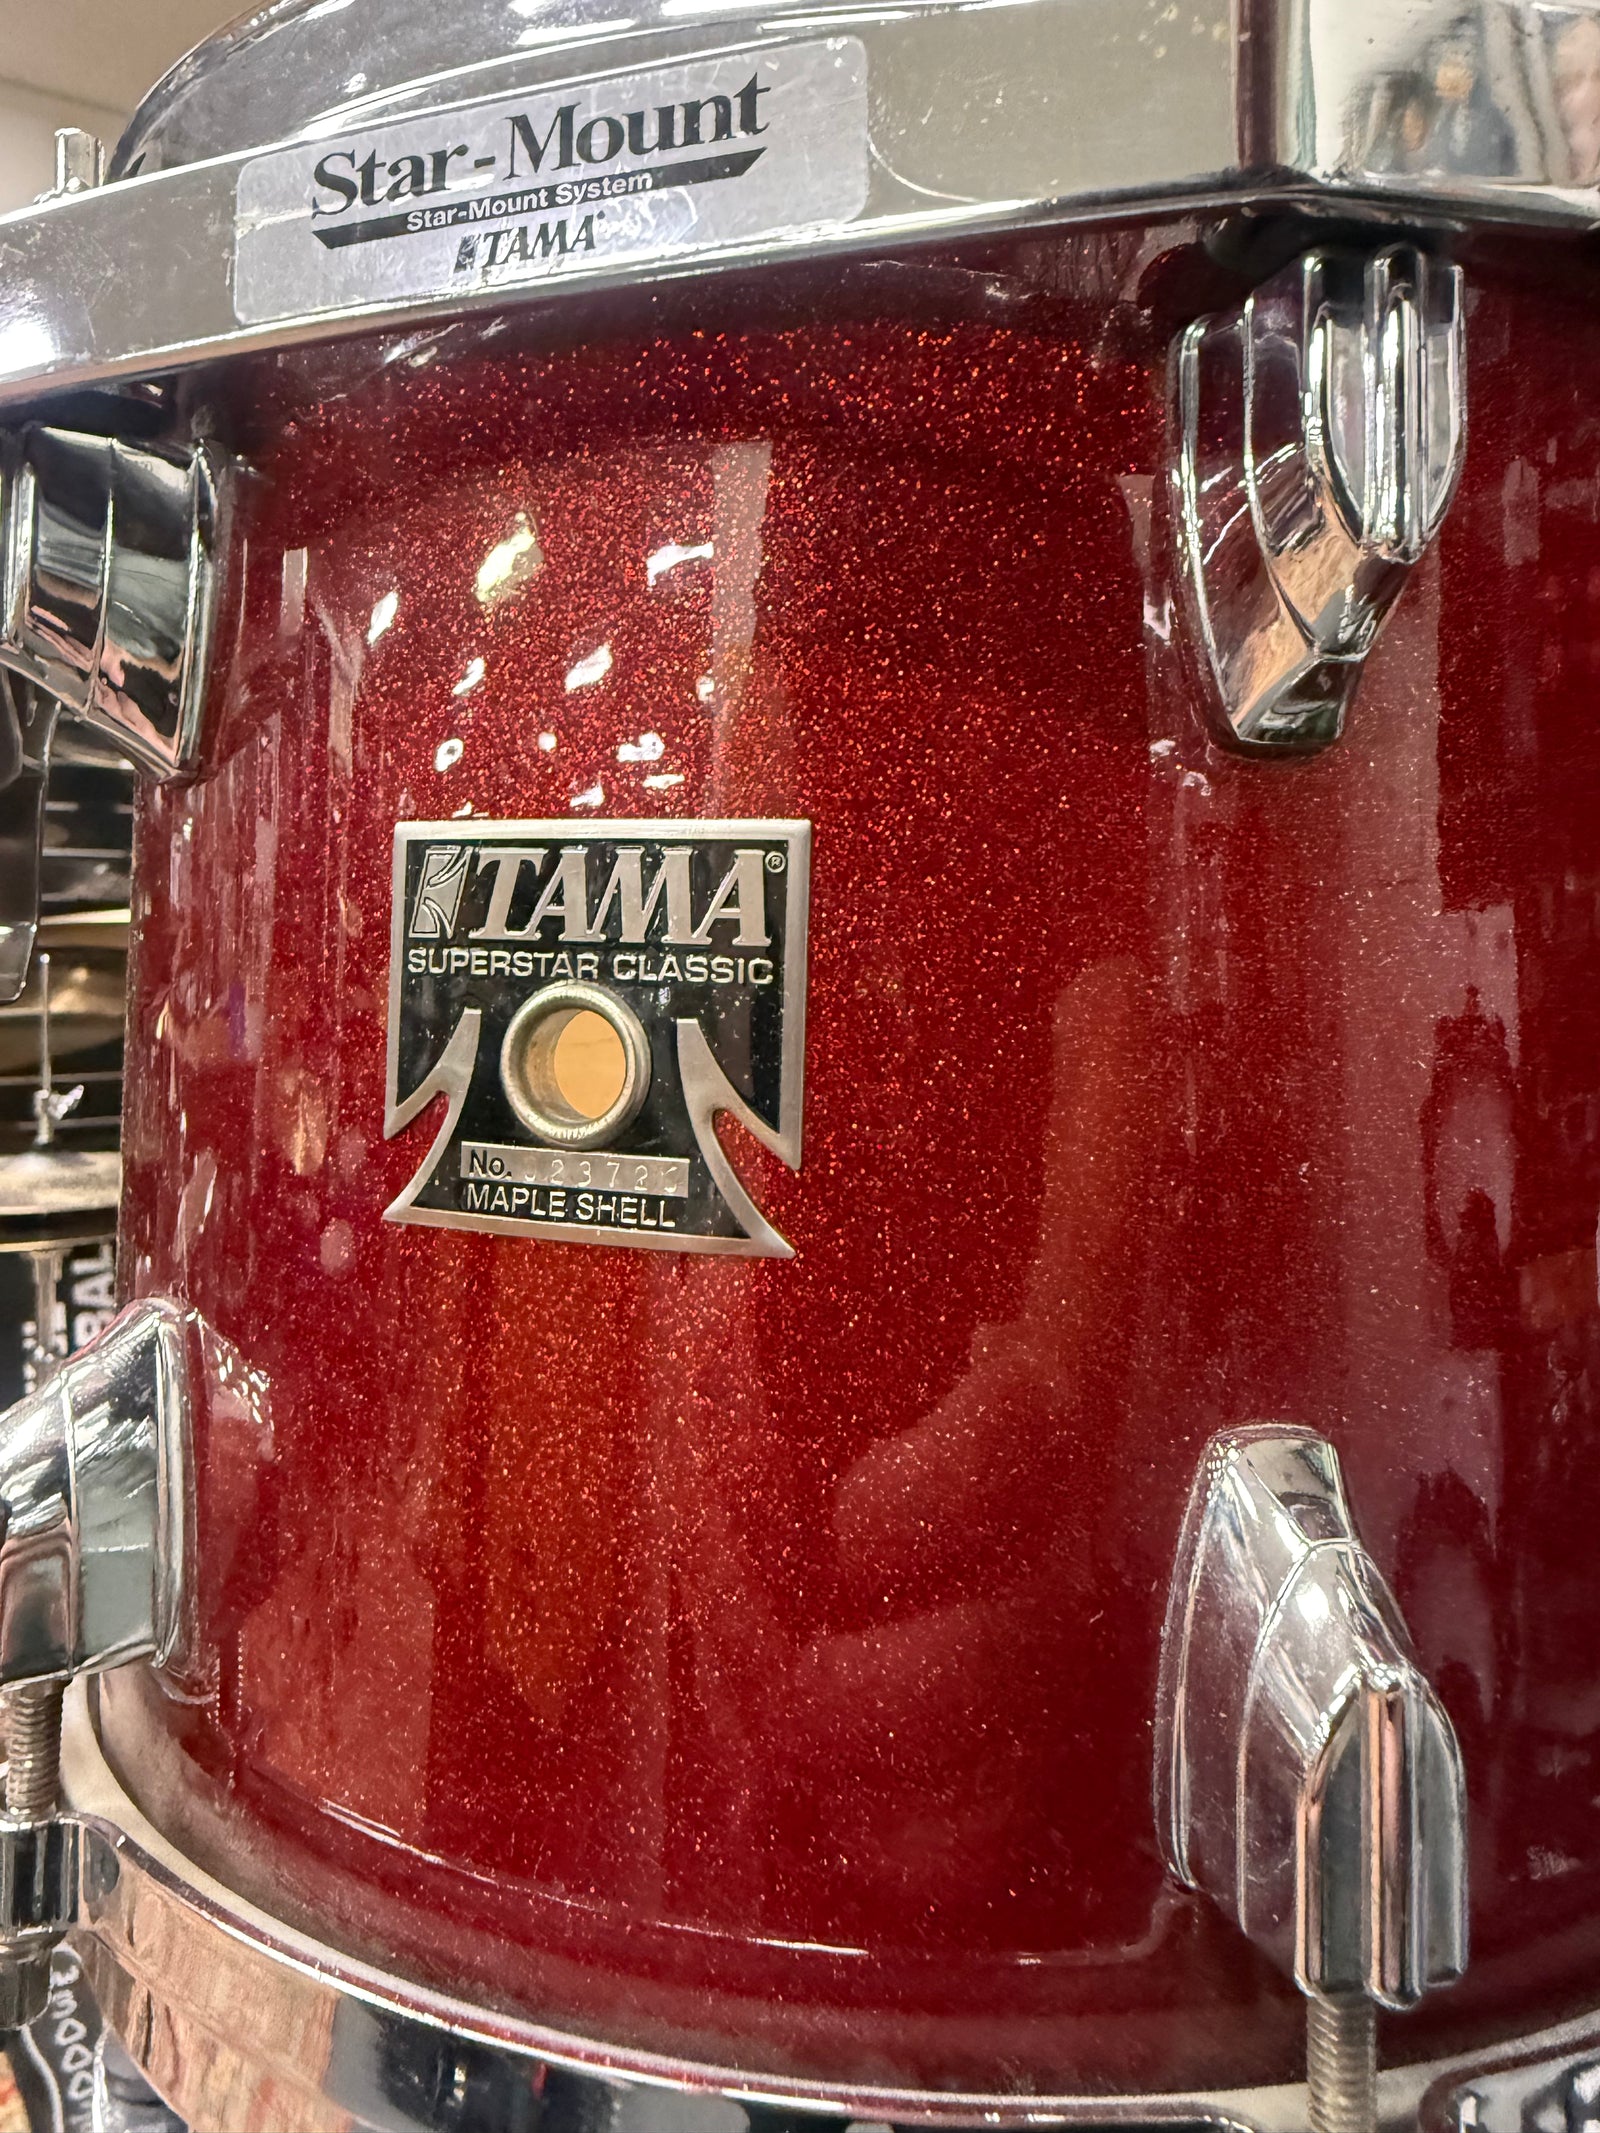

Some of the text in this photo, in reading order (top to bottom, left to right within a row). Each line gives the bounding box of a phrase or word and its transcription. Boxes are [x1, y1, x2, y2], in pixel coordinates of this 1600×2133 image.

[311, 72, 771, 220] Star-Mount
[406, 172, 653, 232] Star-Mount System
[407, 947, 774, 985] SUPERSTAR CLASSIC
[468, 1149, 513, 1179] No.
[466, 1183, 676, 1228] MAPLE SHELL
